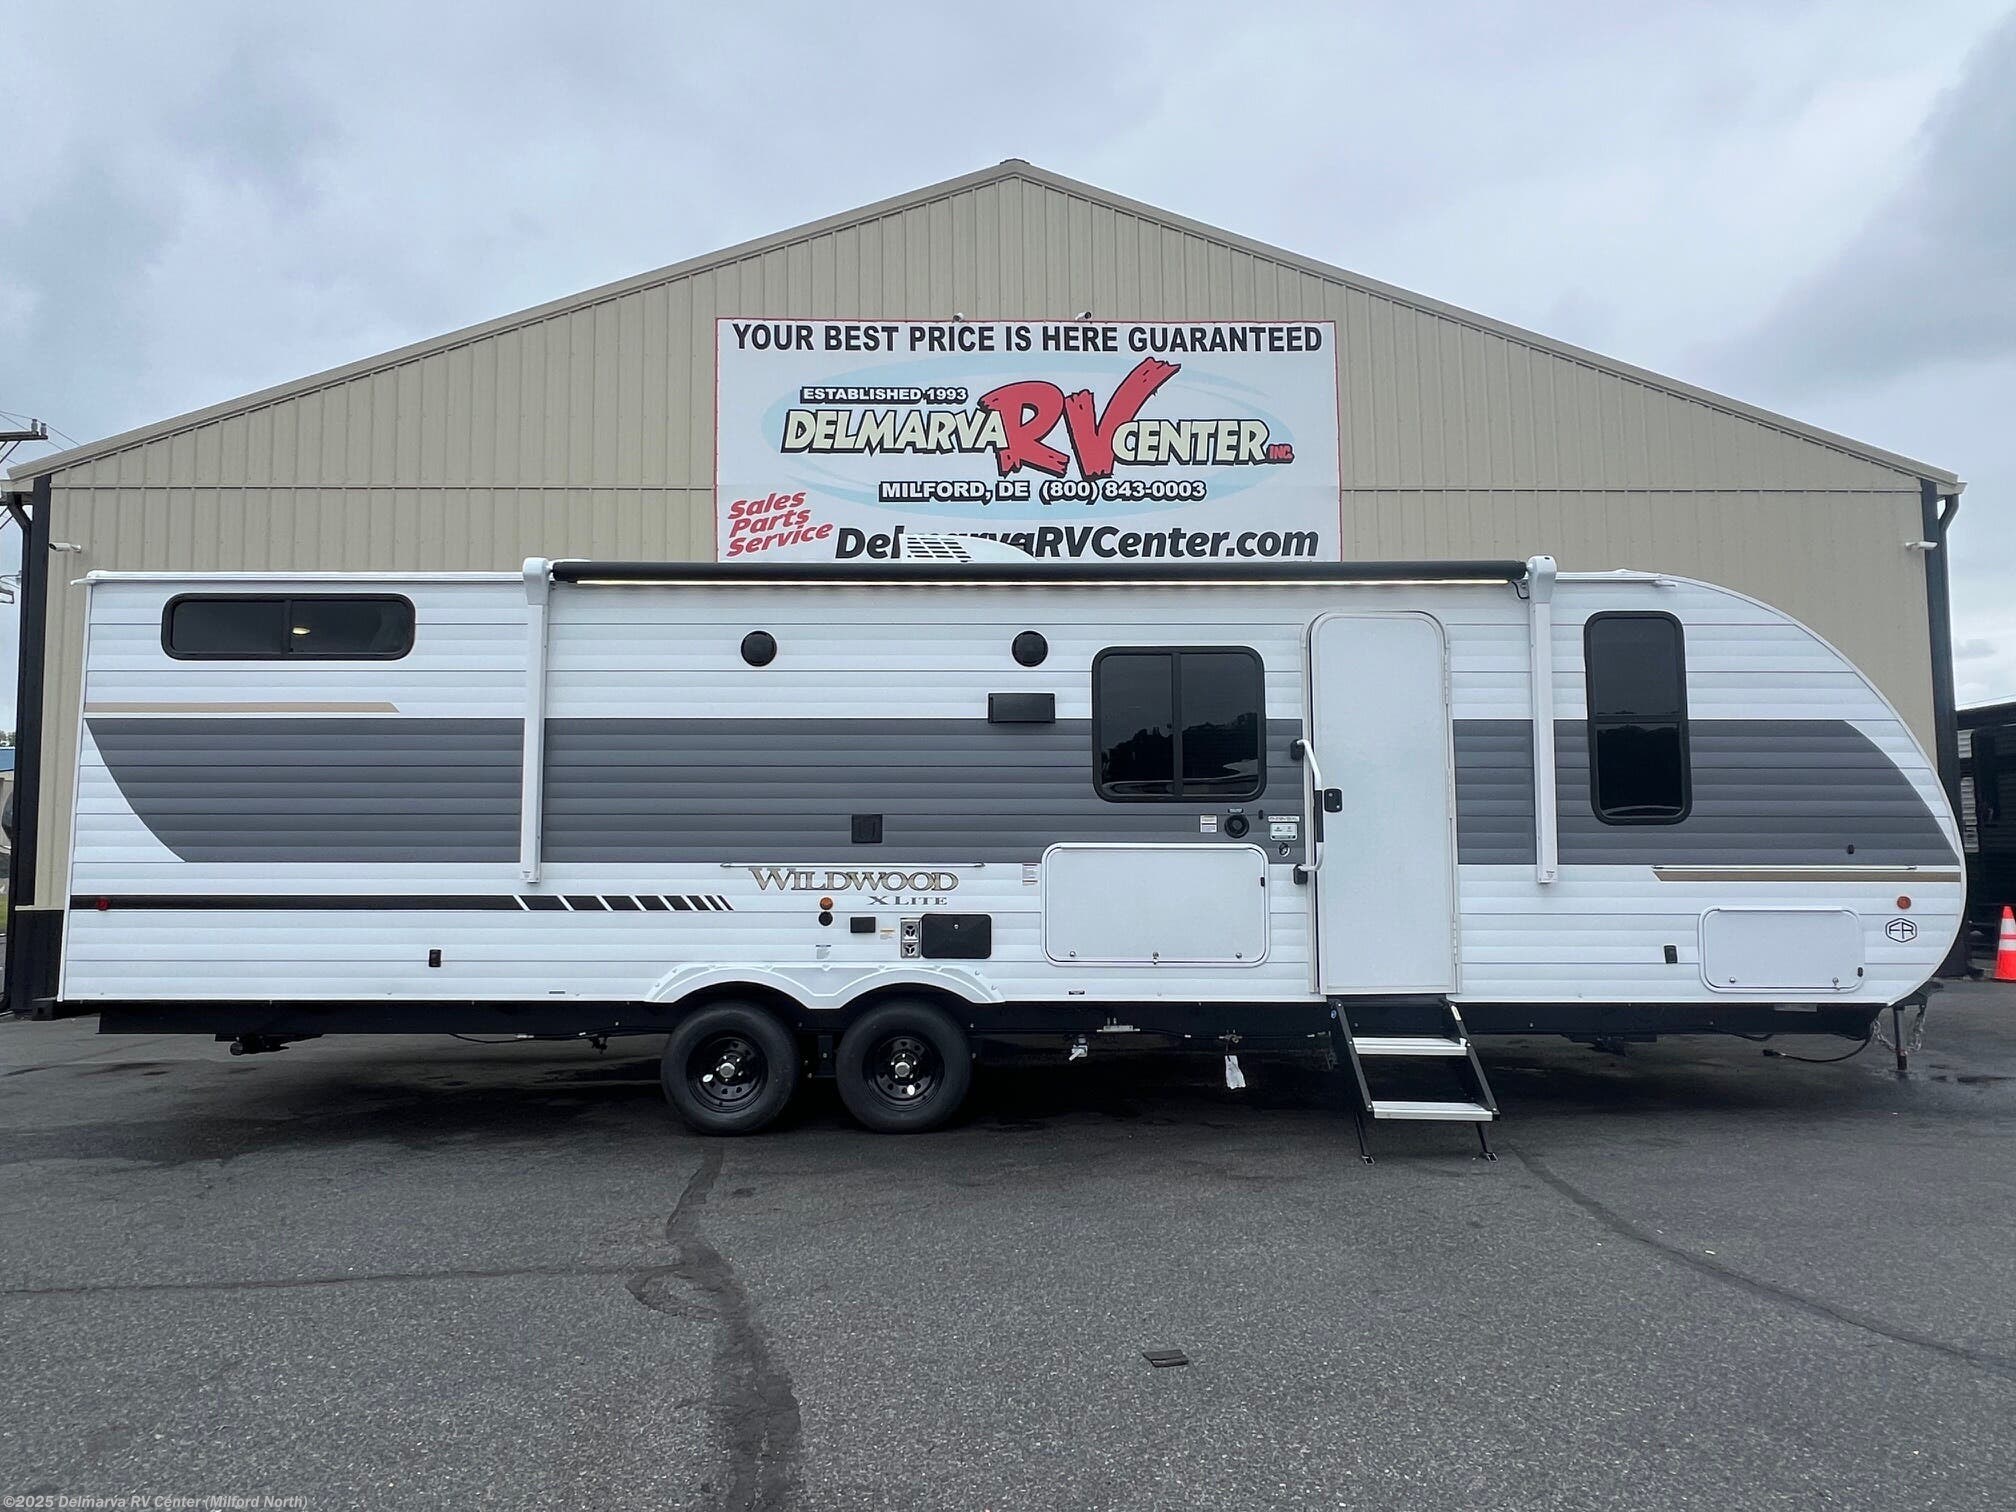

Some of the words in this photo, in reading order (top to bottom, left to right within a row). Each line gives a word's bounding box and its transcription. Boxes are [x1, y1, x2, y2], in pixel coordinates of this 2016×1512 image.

[732, 323, 814, 350] YOUR
[824, 325, 899, 350] BEST
[909, 326, 994, 351] PRICE
[1005, 326, 1032, 351] IS
[1042, 326, 1118, 352] HERE
[1128, 327, 1322, 352] GUARANTEED
[801, 387, 923, 403] ESTABLISHED
[926, 387, 968, 403] 1993
[782, 410, 1009, 455] DELMARVA
[978, 357, 1181, 480] RV
[1112, 420, 1269, 464] CENTER
[1269, 444, 1294, 461] INC.
[728, 491, 806, 520] Sales
[880, 481, 992, 502] MILFORD,
[997, 481, 1030, 500] DE
[1041, 481, 1098, 502] (800)
[1104, 481, 1206, 500] 843-0003
[729, 508, 811, 538] Parts
[726, 523, 834, 557] Service
[835, 525, 1319, 559] DelaRVCenter.com
[748, 867, 959, 891] WILDWOOD
